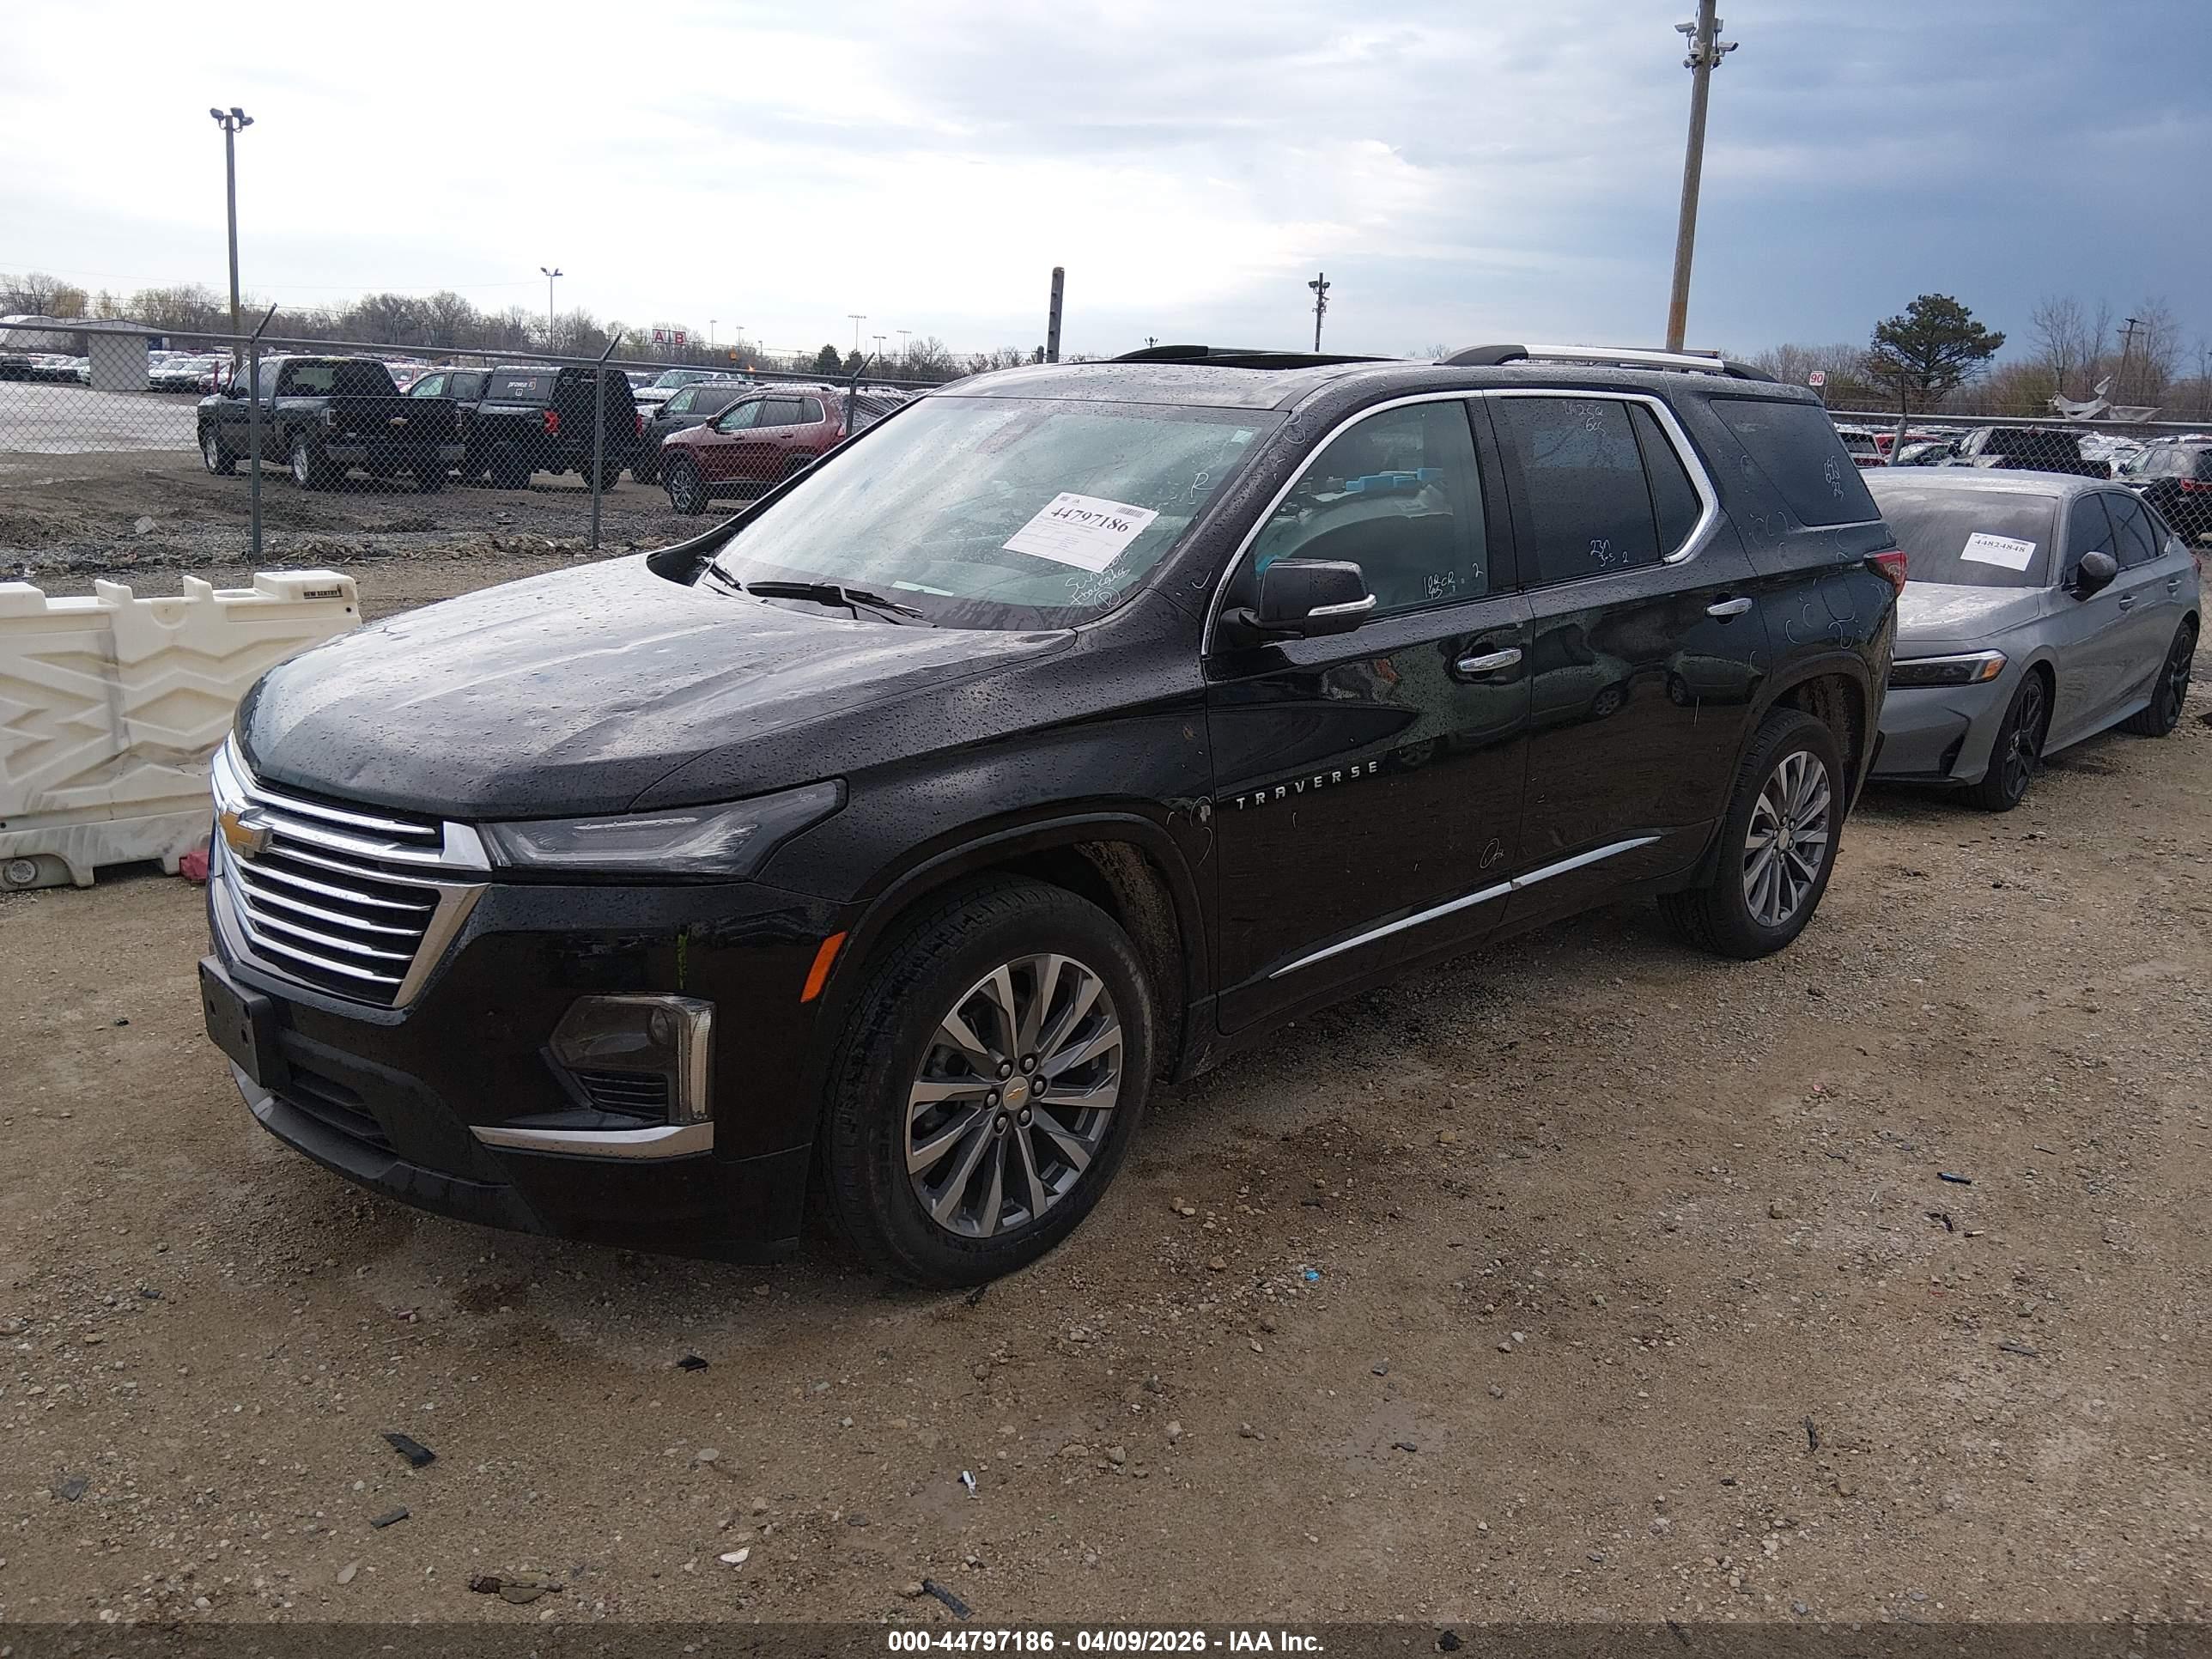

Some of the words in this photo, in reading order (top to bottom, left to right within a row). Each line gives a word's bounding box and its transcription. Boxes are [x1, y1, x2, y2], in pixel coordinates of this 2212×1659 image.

[654, 331, 664, 342] A
[675, 332, 684, 343] B
[1810, 374, 1823, 384] 90
[1050, 506, 1133, 532] 44797186
[1974, 538, 2027, 553] 44824848
[1236, 761, 1377, 810] TRAVERSE
